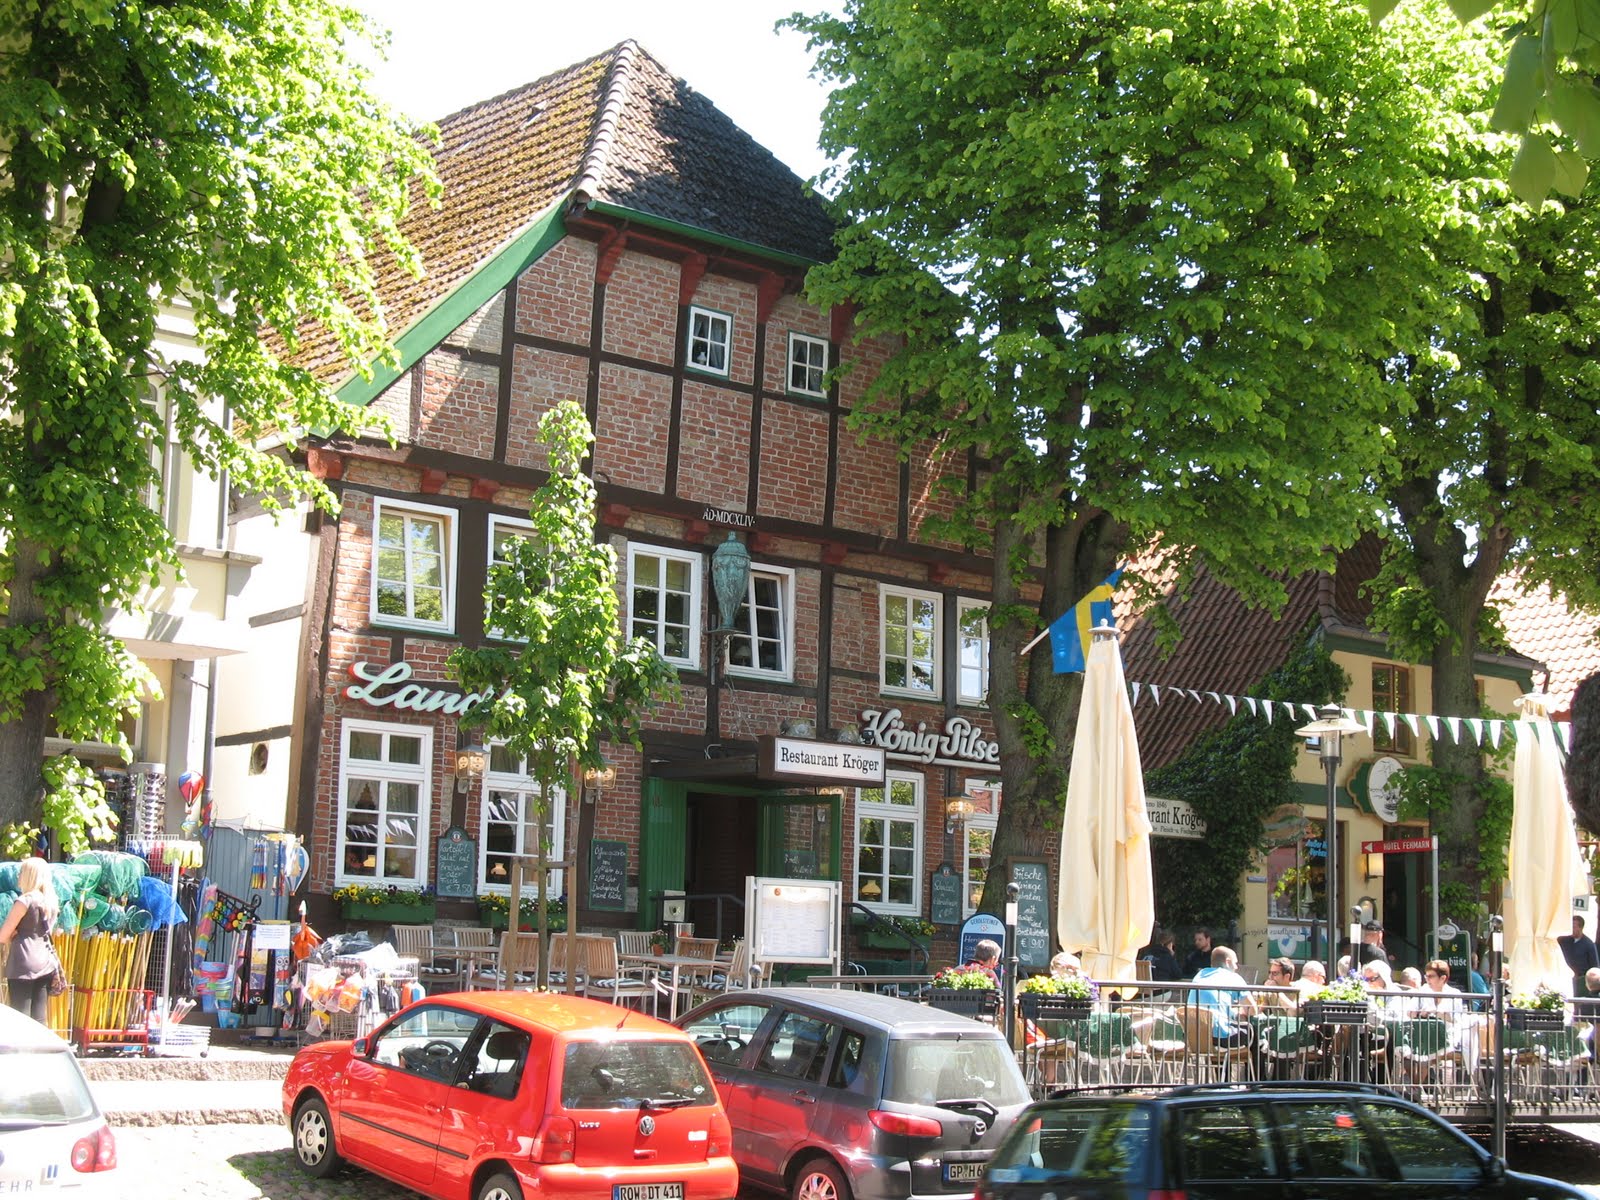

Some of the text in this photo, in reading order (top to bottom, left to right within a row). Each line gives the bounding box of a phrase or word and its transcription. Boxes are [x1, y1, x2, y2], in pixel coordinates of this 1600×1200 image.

[780, 747, 880, 775] Restaurant Kröger
[1384, 840, 1430, 851] HOTEL FEHMARN
[620, 1187, 640, 1200] ROW
[648, 1186, 660, 1200] DT
